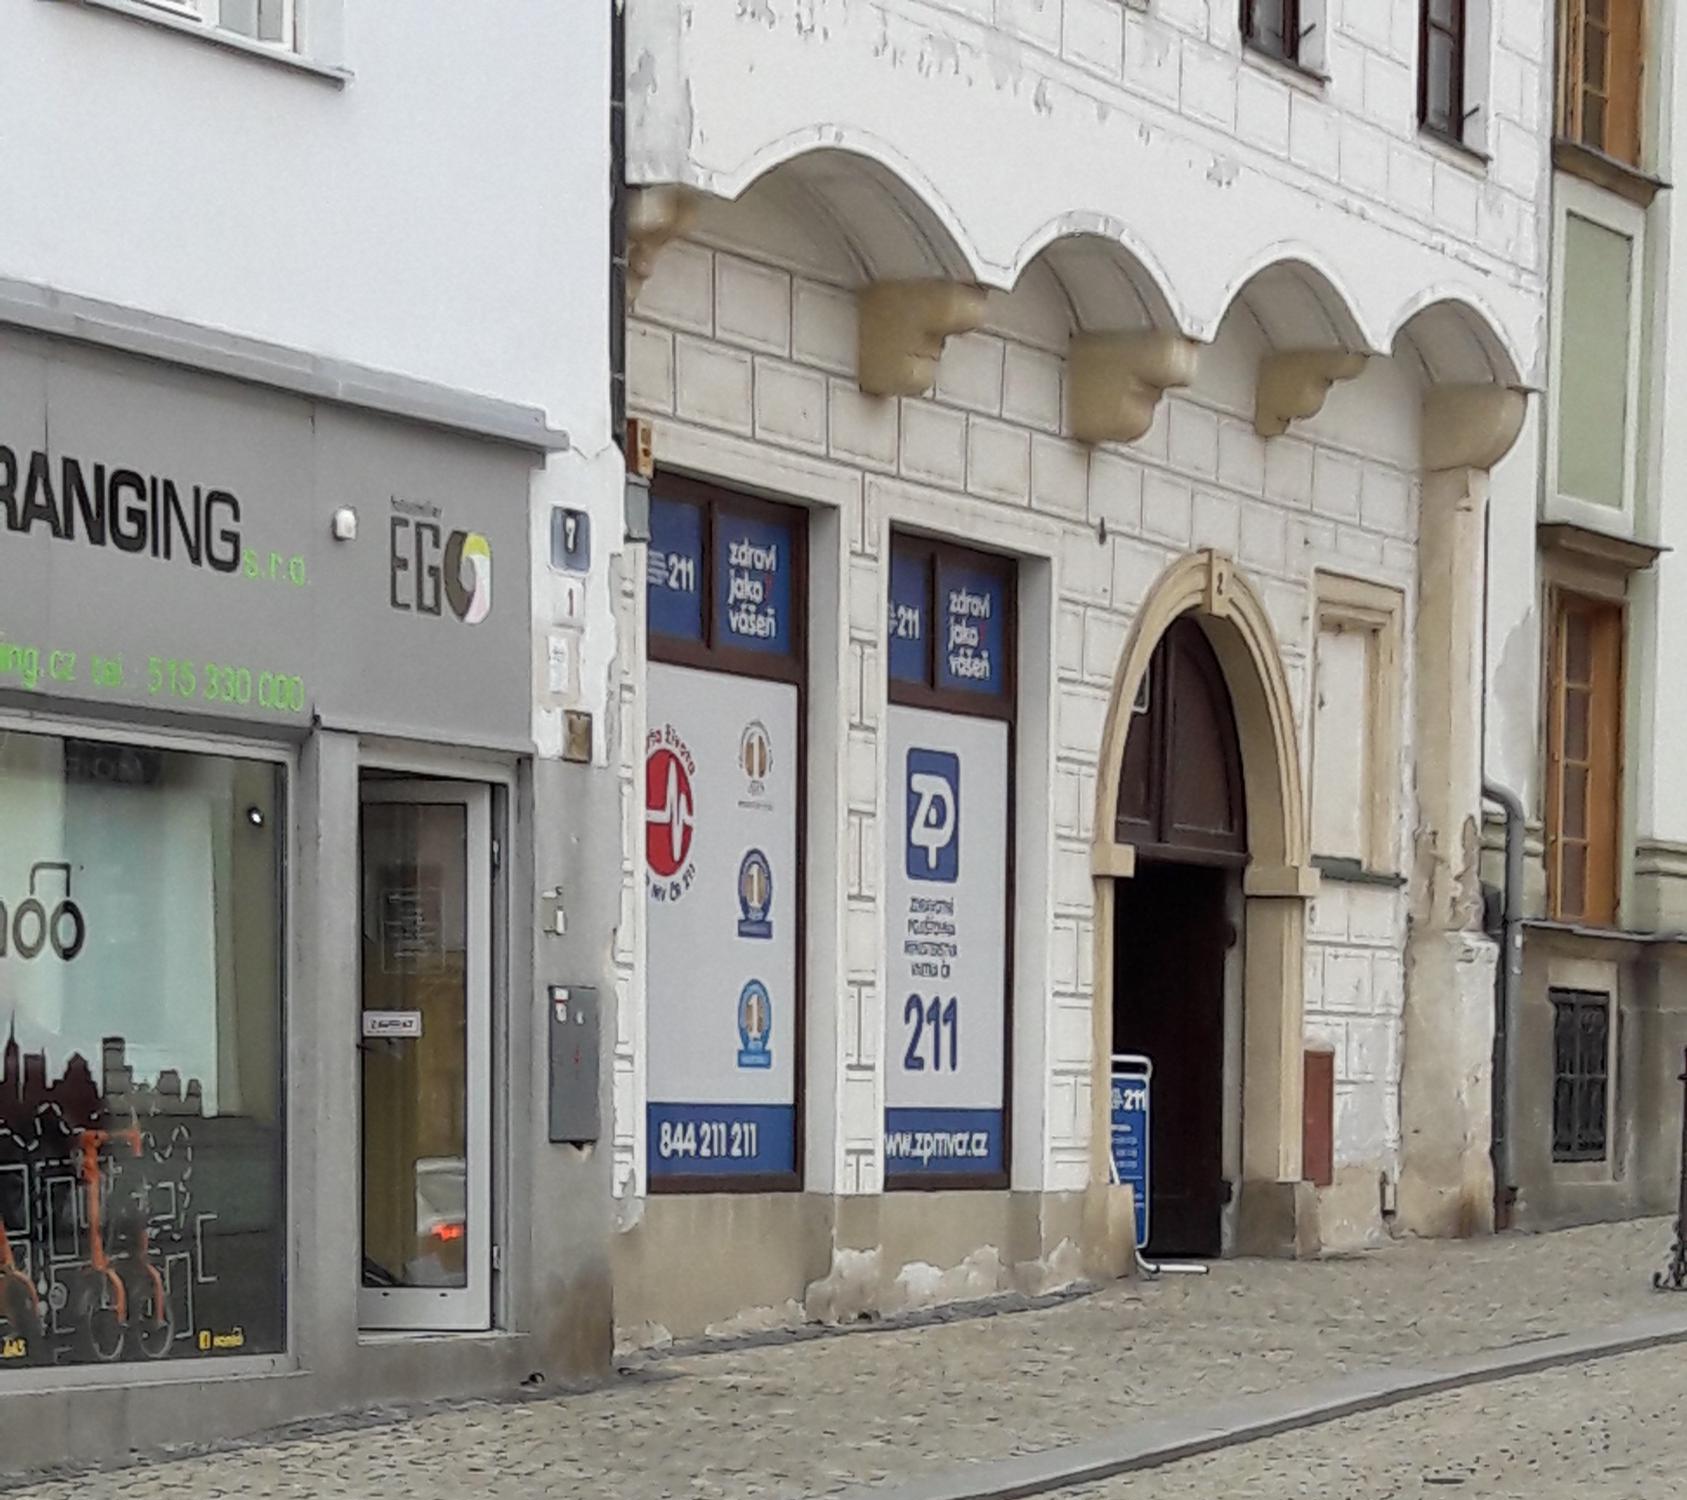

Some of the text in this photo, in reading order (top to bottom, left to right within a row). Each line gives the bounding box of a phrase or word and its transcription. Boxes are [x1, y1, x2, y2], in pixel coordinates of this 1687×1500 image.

[667, 552, 695, 592] 211
[896, 604, 920, 640] 211
[904, 993, 958, 1071] 211
[659, 1120, 757, 1158] 844 211 211
